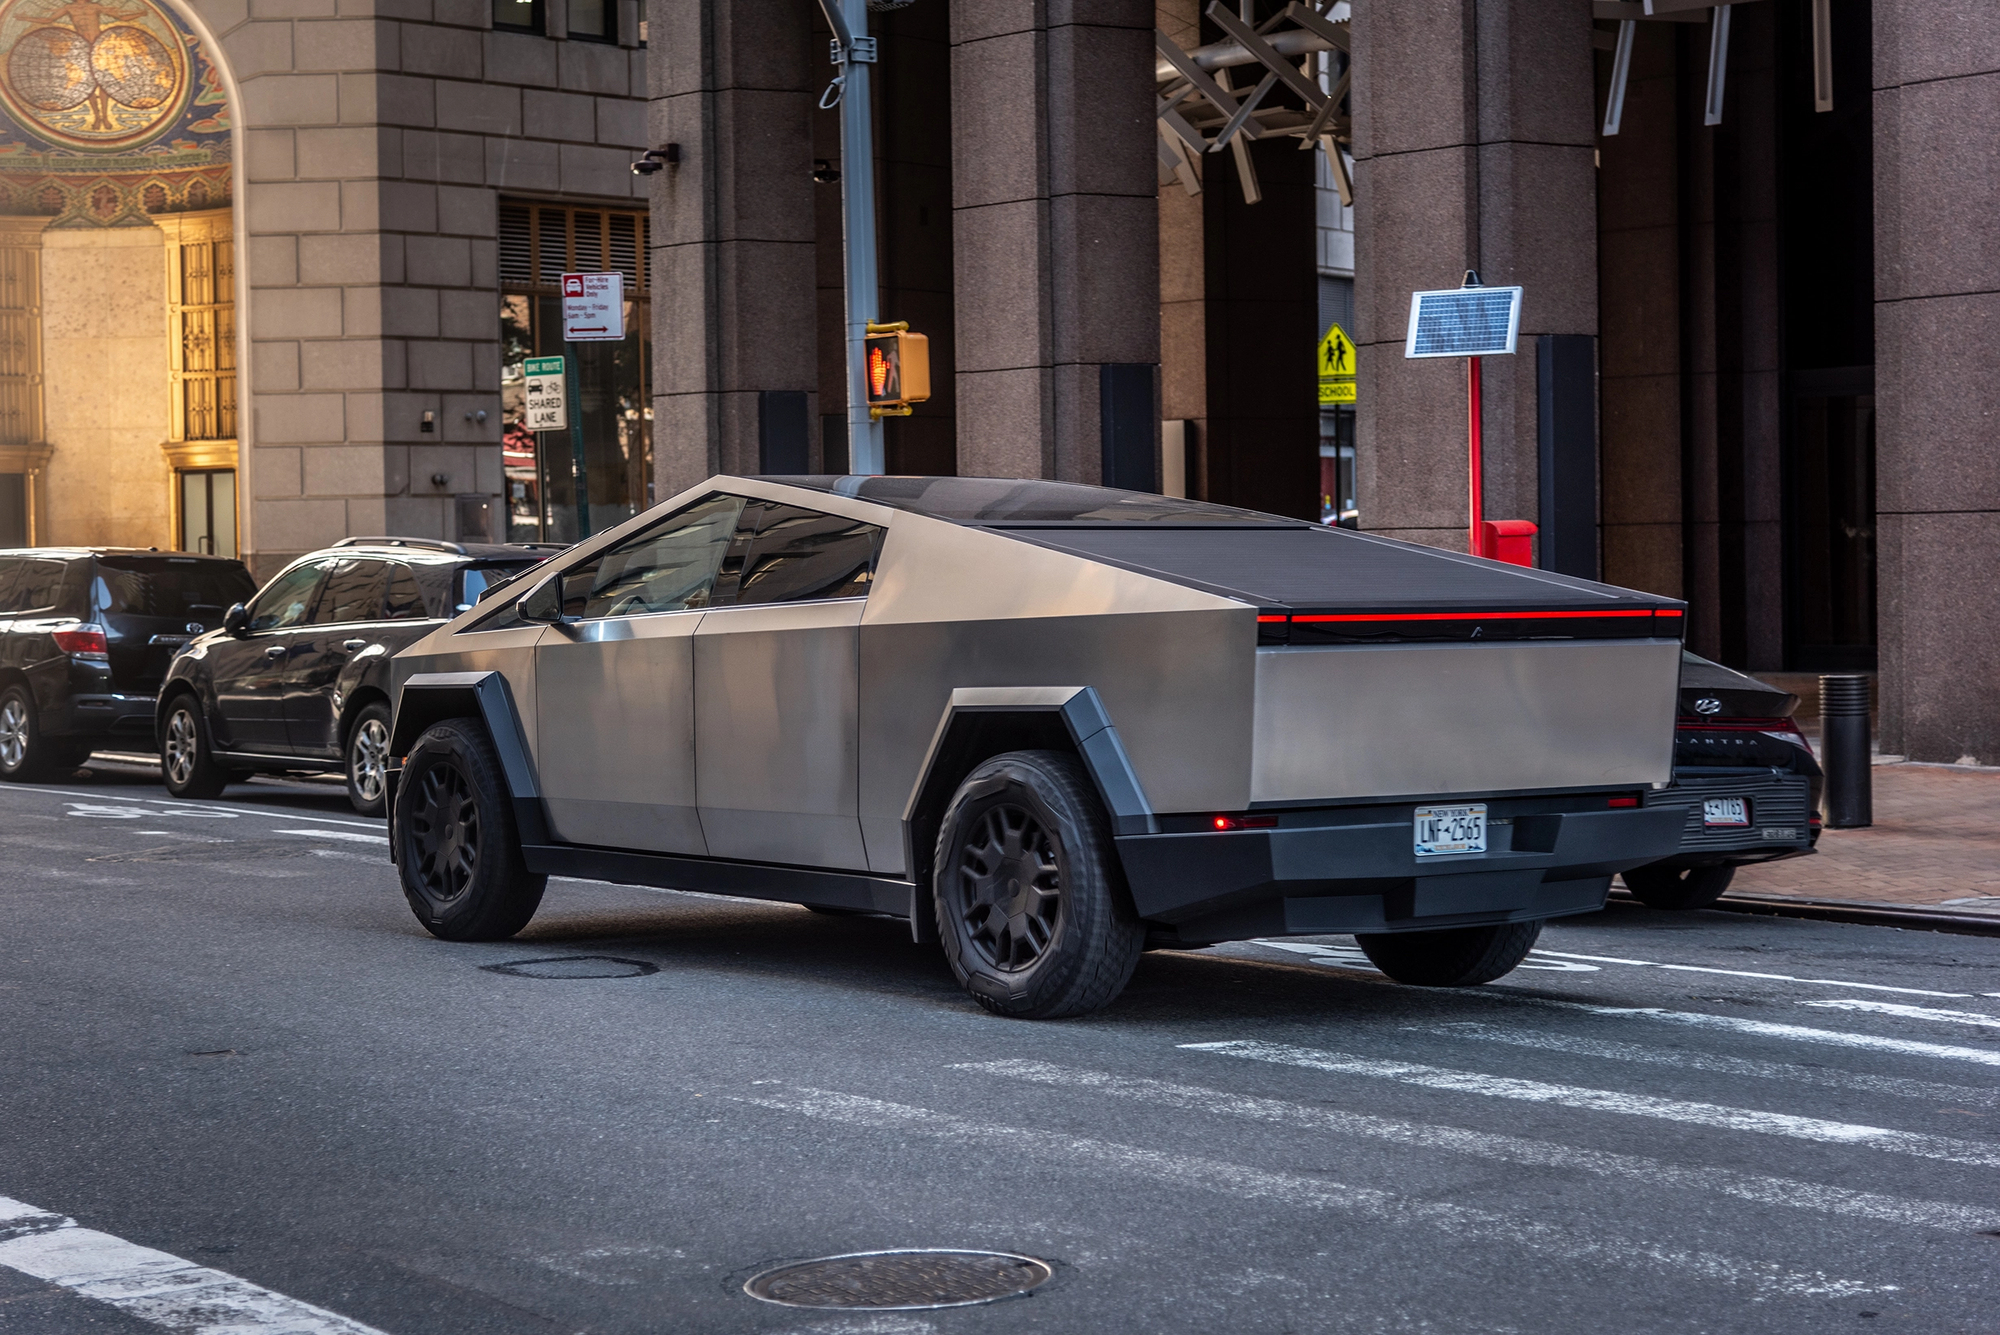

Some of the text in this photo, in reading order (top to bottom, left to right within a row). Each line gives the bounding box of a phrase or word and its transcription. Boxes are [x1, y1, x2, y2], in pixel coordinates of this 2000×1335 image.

[526, 361, 561, 373] BIKE ROUTE
[1318, 386, 1354, 397] SCHOOL
[528, 397, 562, 410] SHARED
[534, 411, 557, 424] LANE
[1675, 737, 1759, 746] LANTRA
[1432, 809, 1470, 818] NEW YORK
